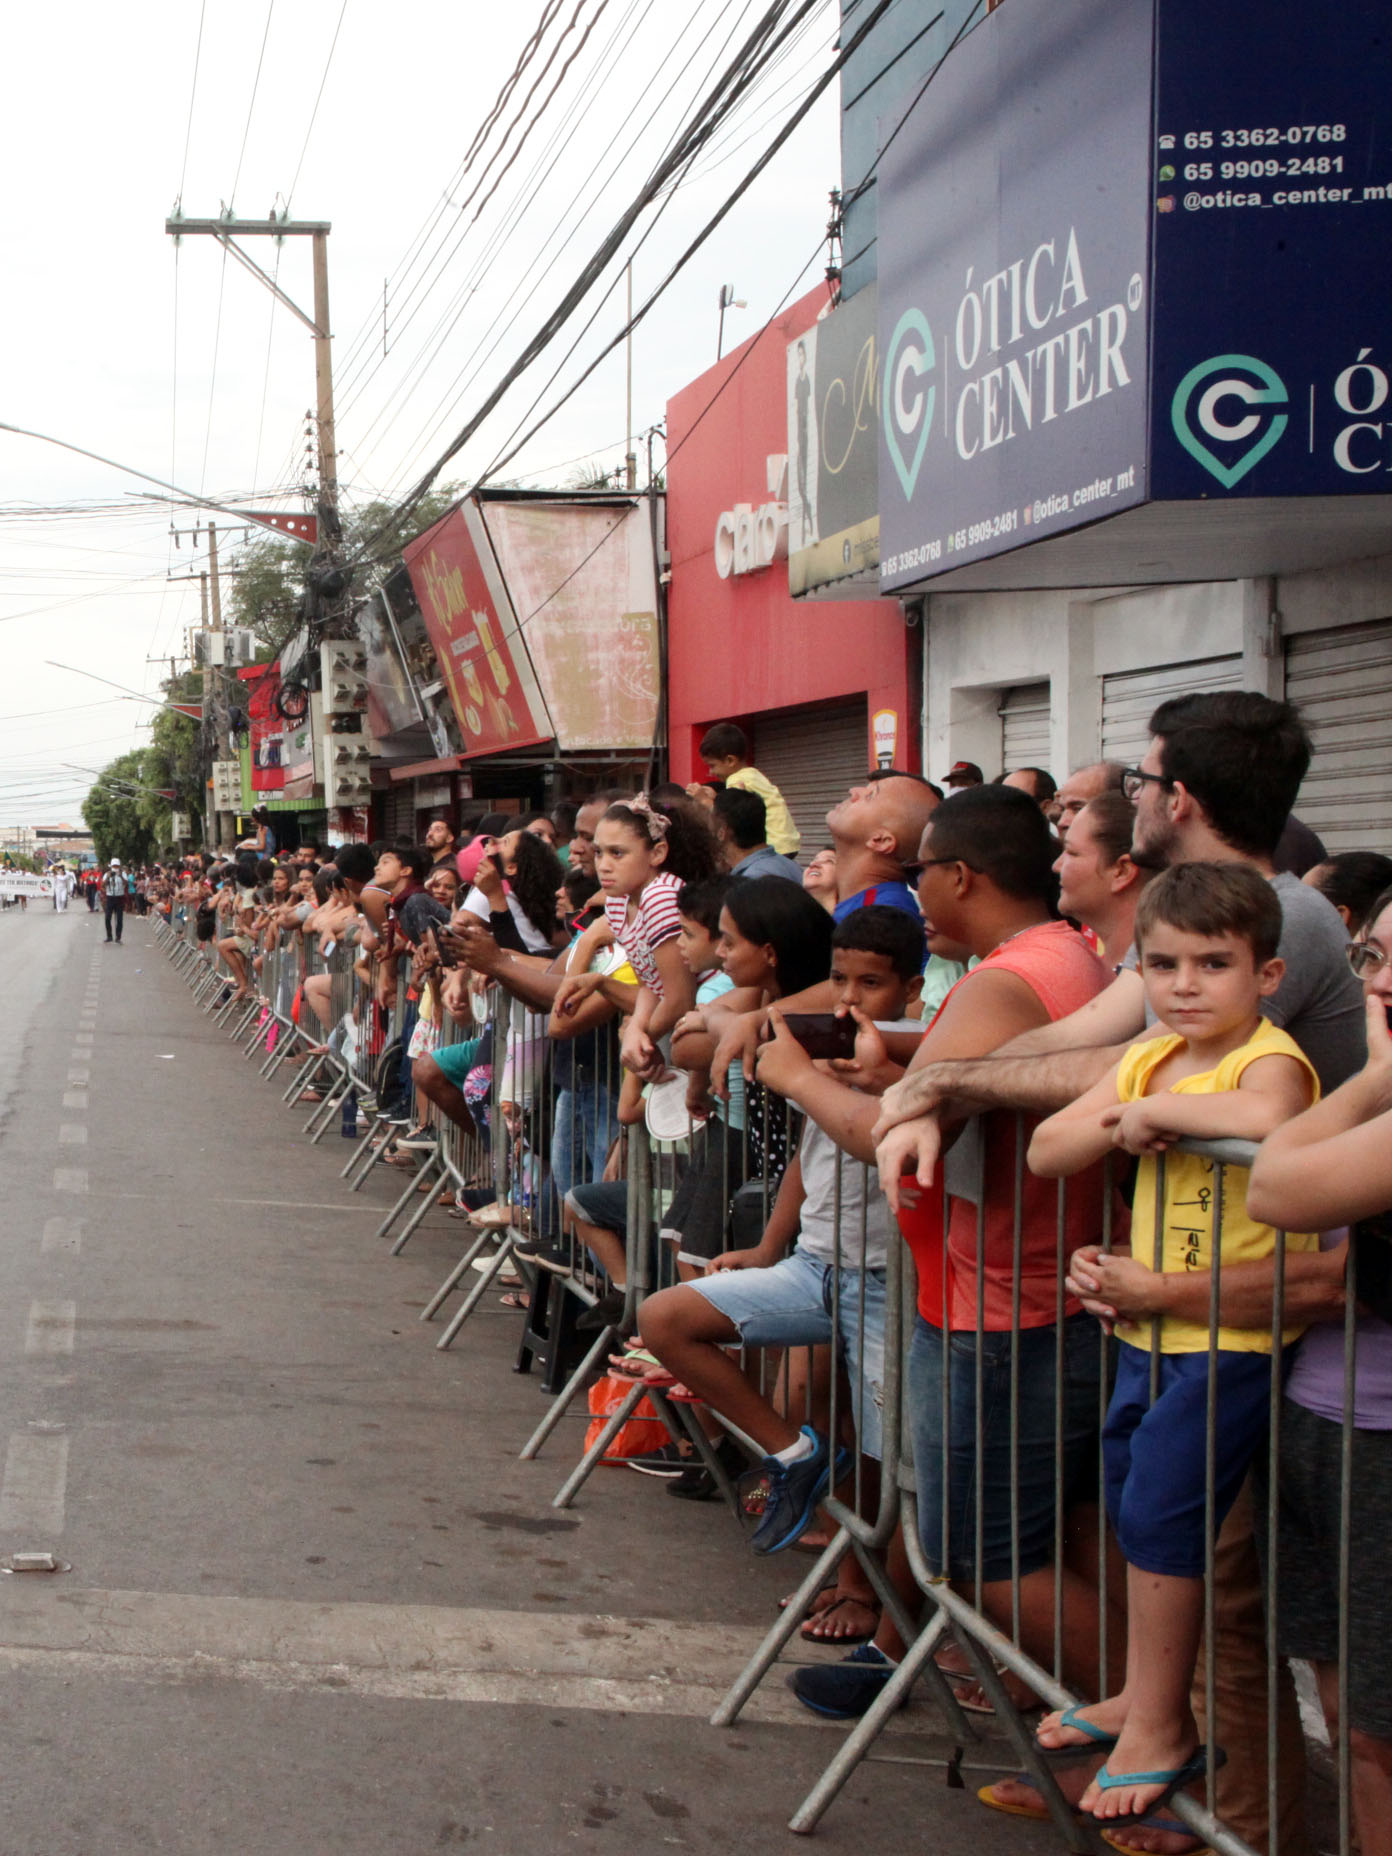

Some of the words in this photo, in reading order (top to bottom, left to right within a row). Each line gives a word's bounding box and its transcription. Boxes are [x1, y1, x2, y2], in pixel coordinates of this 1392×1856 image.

[1184, 131, 1213, 149] 65
[1221, 124, 1346, 148] 3362-0768
[1184, 163, 1213, 180] 65
[1220, 156, 1344, 179] 9909-2481
[955, 225, 1089, 372] ÓTICA
[955, 303, 1132, 460] CENTER
[714, 502, 784, 580] Claro
[888, 558, 898, 575] 65
[898, 540, 942, 569] 3362-0768
[955, 530, 966, 551] 65
[968, 509, 1019, 546] 9909-2481
[1032, 464, 1135, 523] @otica_center_mt
